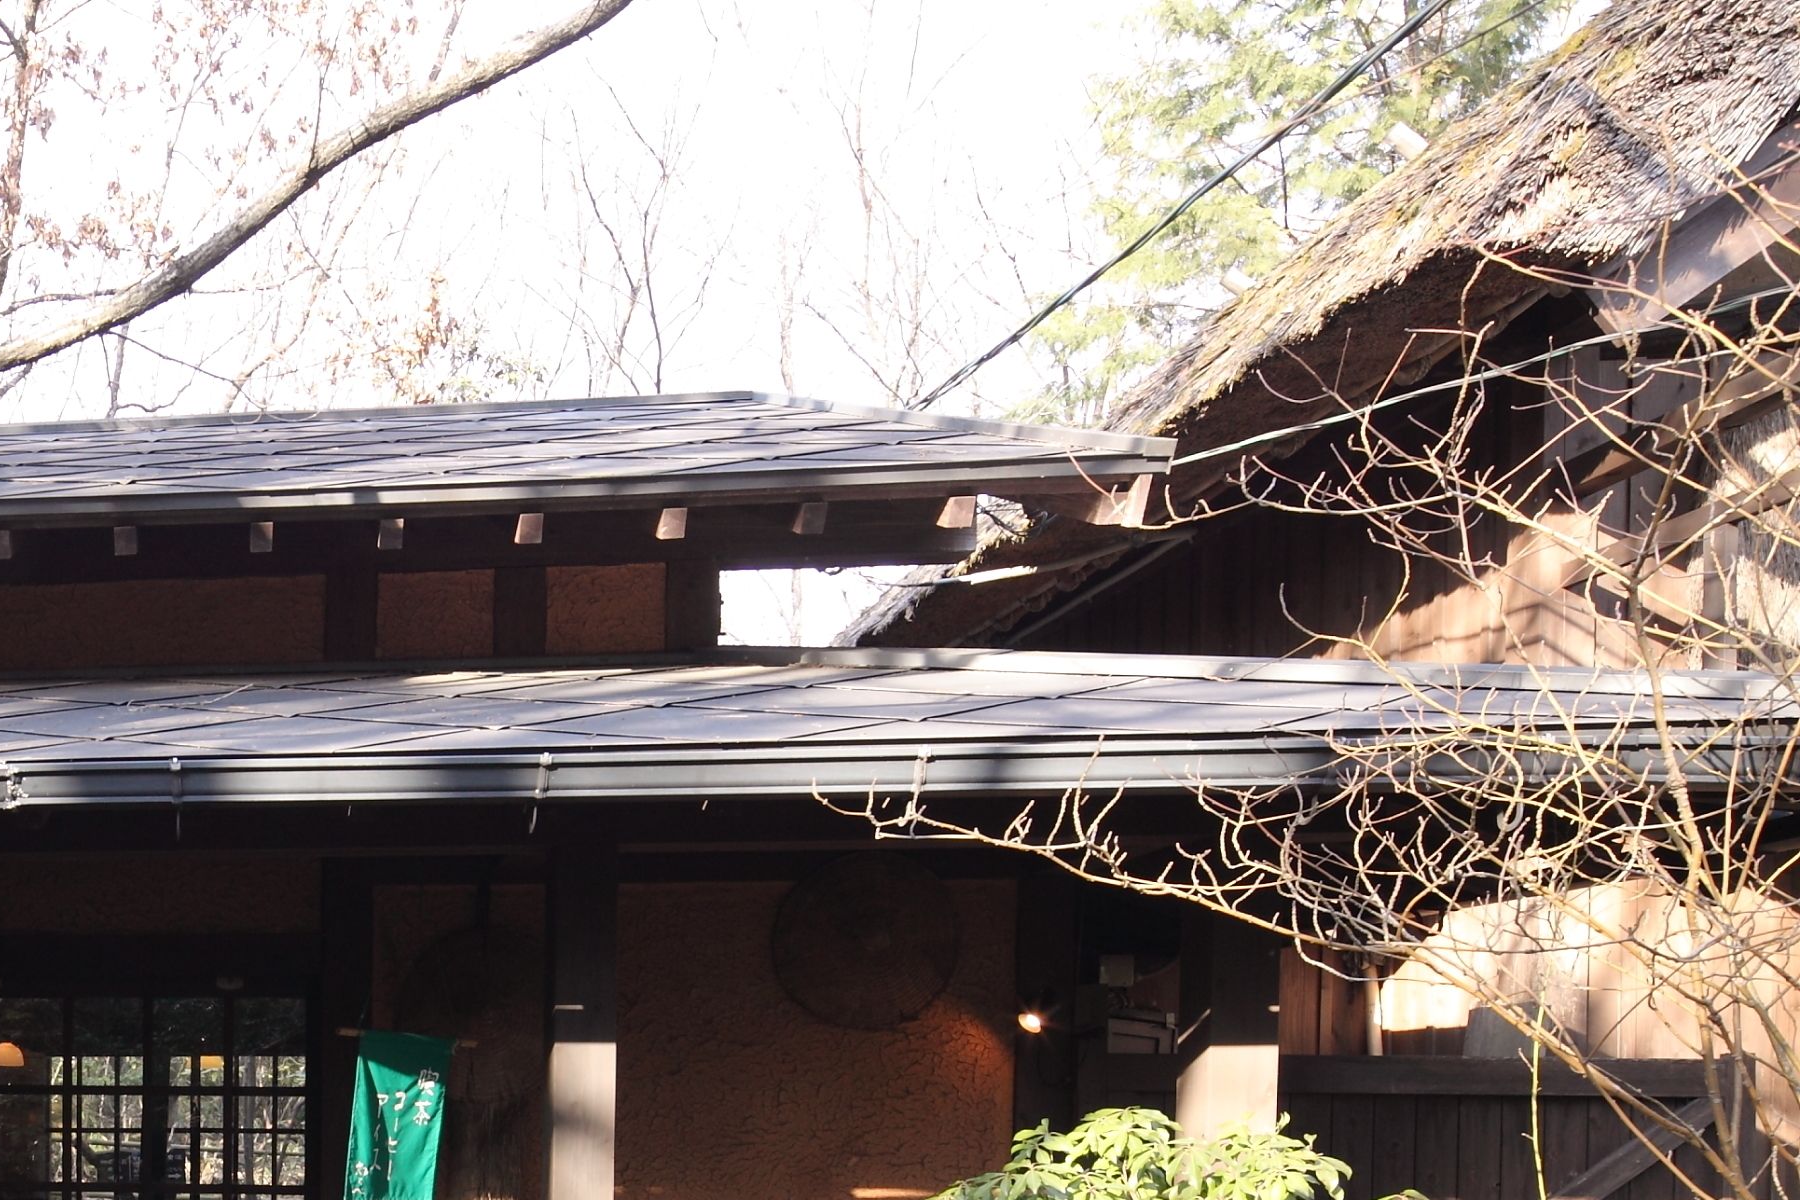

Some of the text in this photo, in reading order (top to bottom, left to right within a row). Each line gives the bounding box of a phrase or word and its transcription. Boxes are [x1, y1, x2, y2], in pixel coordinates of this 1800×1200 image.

[369, 1092, 389, 1176] アイス
[387, 1091, 406, 1182] コーヒー
[413, 1067, 440, 1127] 喫茶
